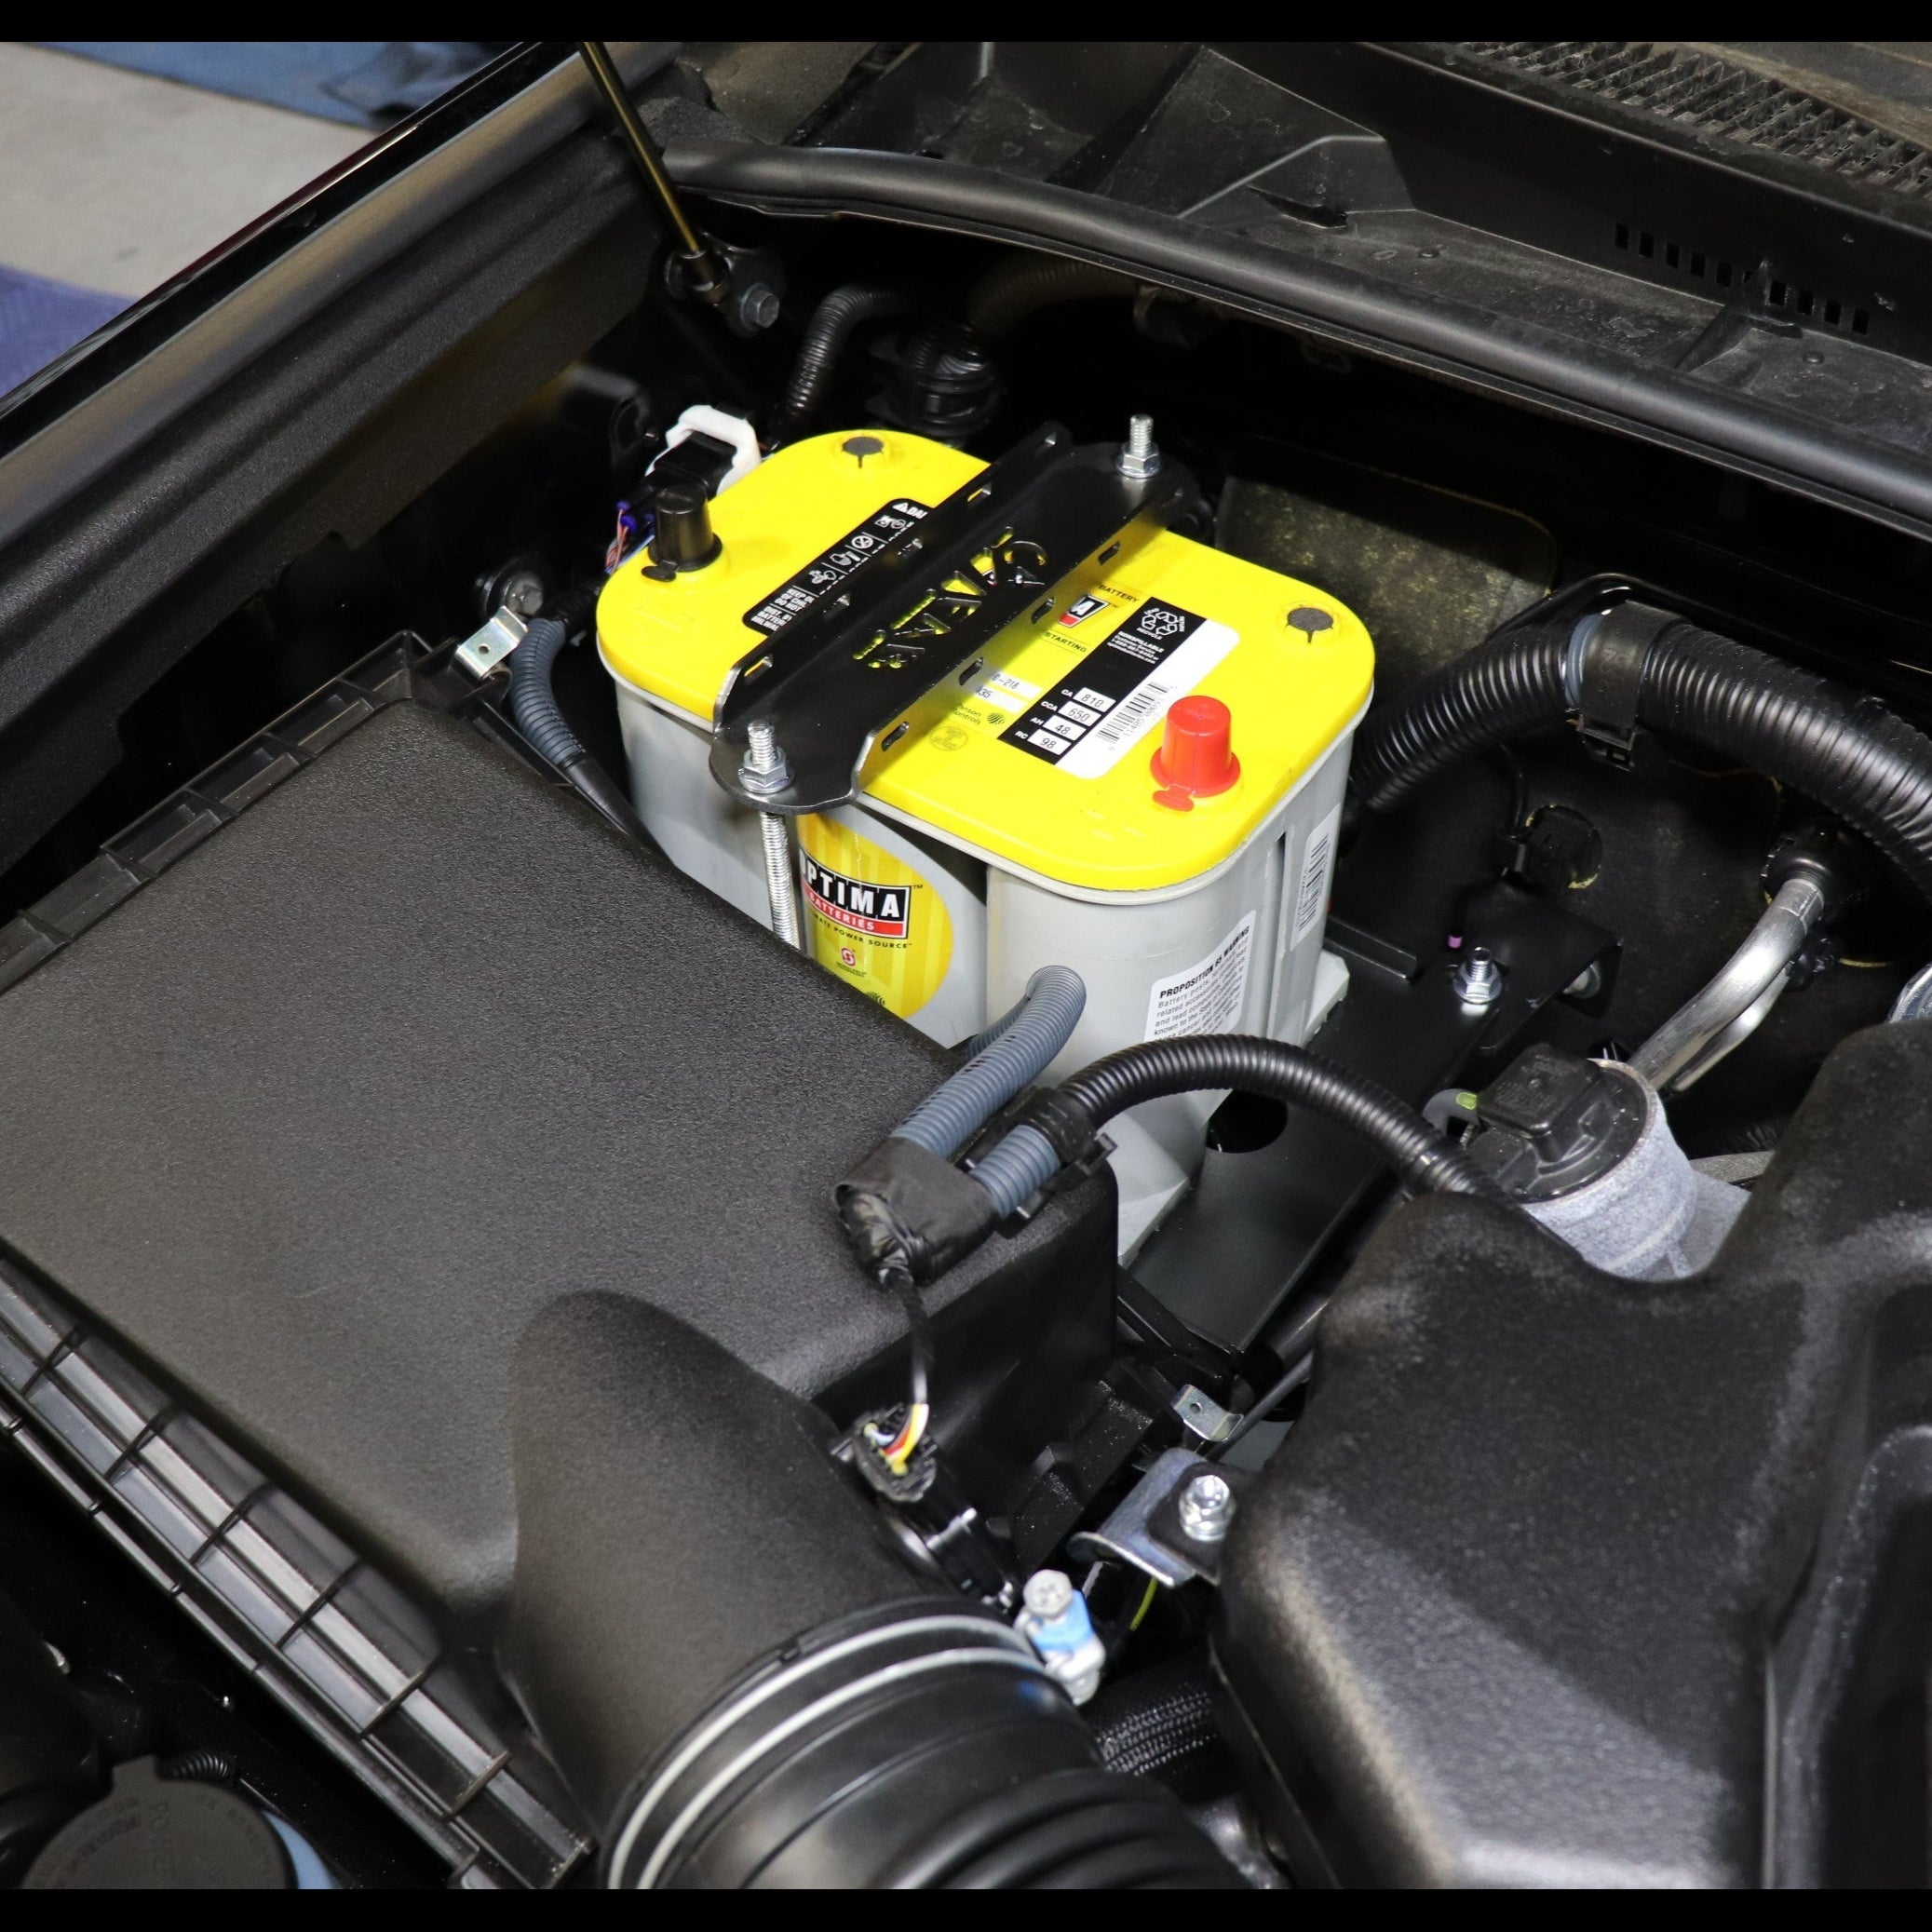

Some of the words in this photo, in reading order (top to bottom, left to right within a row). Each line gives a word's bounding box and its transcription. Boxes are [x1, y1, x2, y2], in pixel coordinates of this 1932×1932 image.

[787, 588, 806, 598] KEEP
[1099, 584, 1140, 603] BATTERY
[774, 598, 788, 606] DO
[785, 602, 803, 612] NOT
[1045, 631, 1087, 653] STARTING
[1117, 630, 1165, 653] NONSPILLABLE
[1136, 627, 1163, 641] RECYCLE
[1061, 689, 1074, 697] CA
[1081, 694, 1104, 709] 810
[1041, 700, 1058, 712] CCA
[1068, 708, 1091, 723] 650
[1030, 717, 1044, 726] AH
[1055, 723, 1071, 736] 48
[1015, 731, 1029, 739] RC
[1039, 737, 1057, 750] 98
[834, 926, 864, 942] POWER
[869, 939, 908, 949] SOURCE
[1159, 964, 1213, 999] PROPOSITION
[1157, 1004, 1183, 1017] related
[1158, 994, 1187, 1009] Battery
[1155, 1016, 1170, 1027] and
[1172, 1009, 1187, 1020] lead
[1154, 1023, 1179, 1035] known
